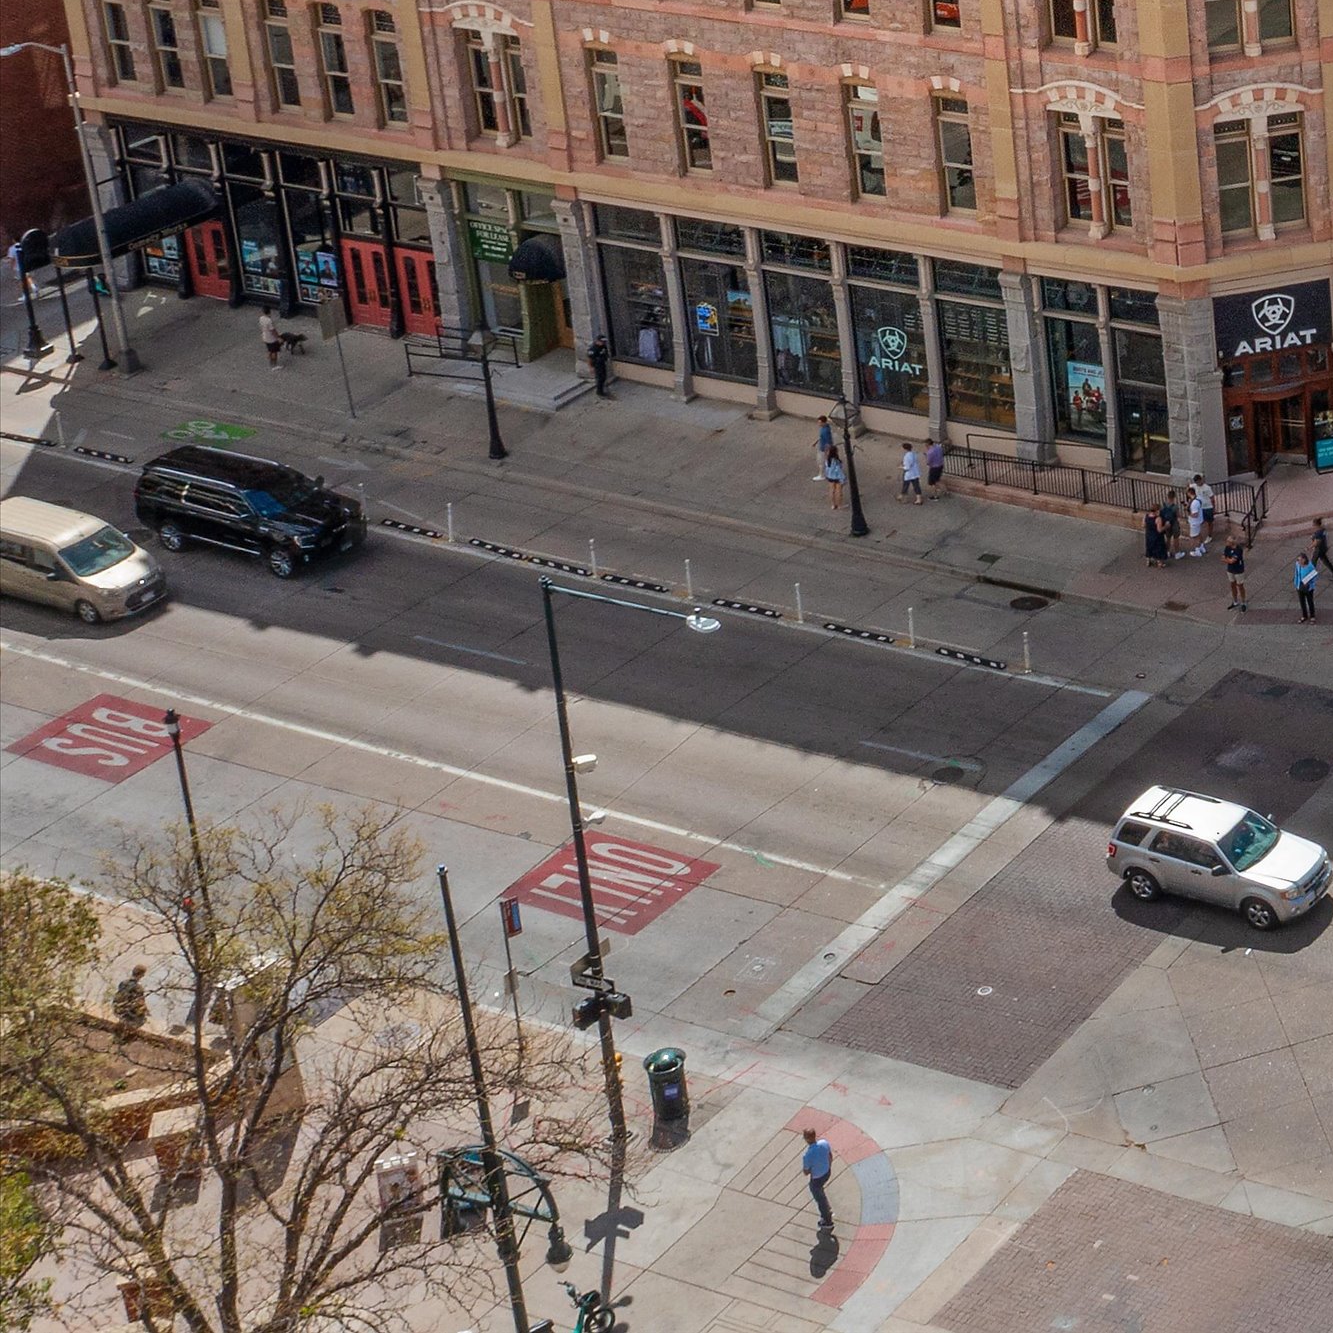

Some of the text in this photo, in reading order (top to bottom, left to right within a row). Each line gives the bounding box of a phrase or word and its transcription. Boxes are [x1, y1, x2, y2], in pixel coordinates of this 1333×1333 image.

[1235, 328, 1317, 357] ARIAT
[868, 355, 923, 375] ARIAT
[42, 707, 169, 767] BUS
[529, 842, 691, 925] ONLY
